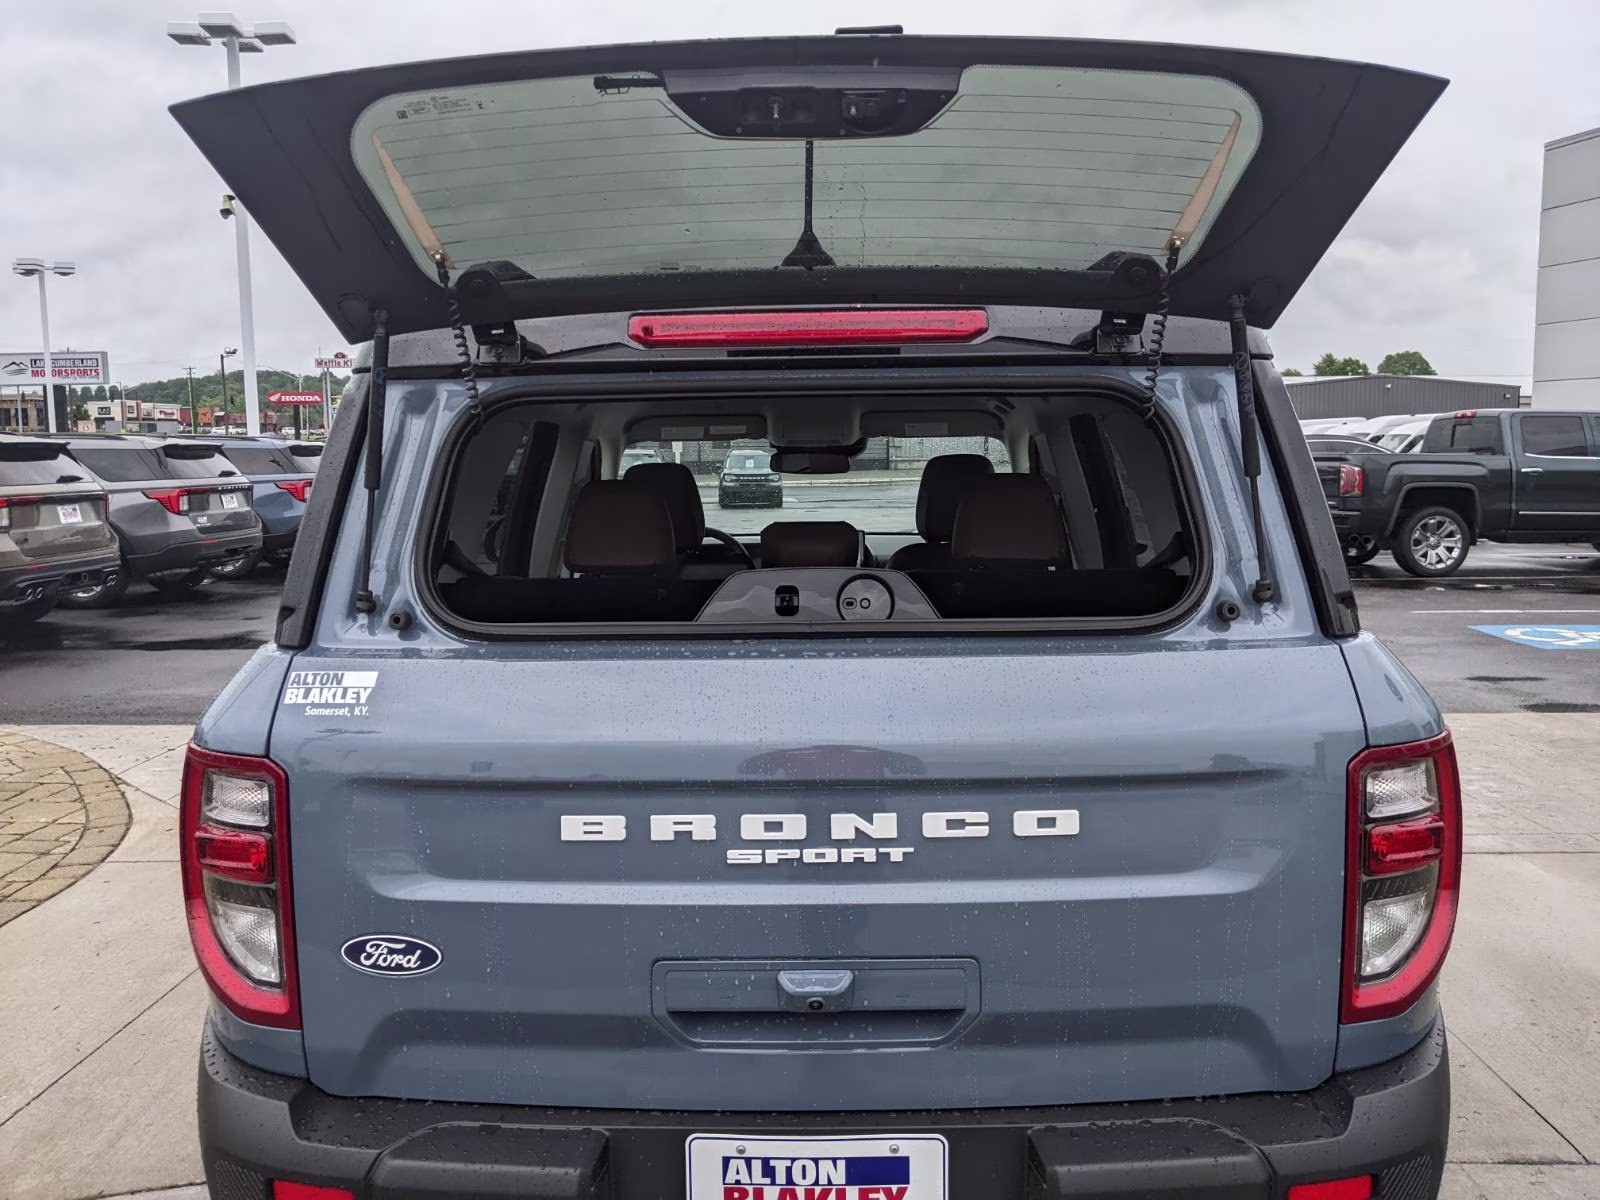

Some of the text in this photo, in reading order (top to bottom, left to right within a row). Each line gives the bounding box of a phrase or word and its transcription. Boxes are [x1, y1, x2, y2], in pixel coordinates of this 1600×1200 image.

[51, 359, 98, 367] CUMBERLAND
[316, 359, 353, 367] Waffle Ki
[31, 368, 100, 378] MOORSPORTS
[289, 672, 345, 686] ALTON
[283, 687, 373, 704] BLAKLEY
[304, 705, 369, 717] Somerset, KY.
[560, 809, 1080, 842] BRONCO
[726, 847, 915, 864] SPORT
[360, 940, 422, 969] Ford
[724, 1158, 846, 1186] ALTON
